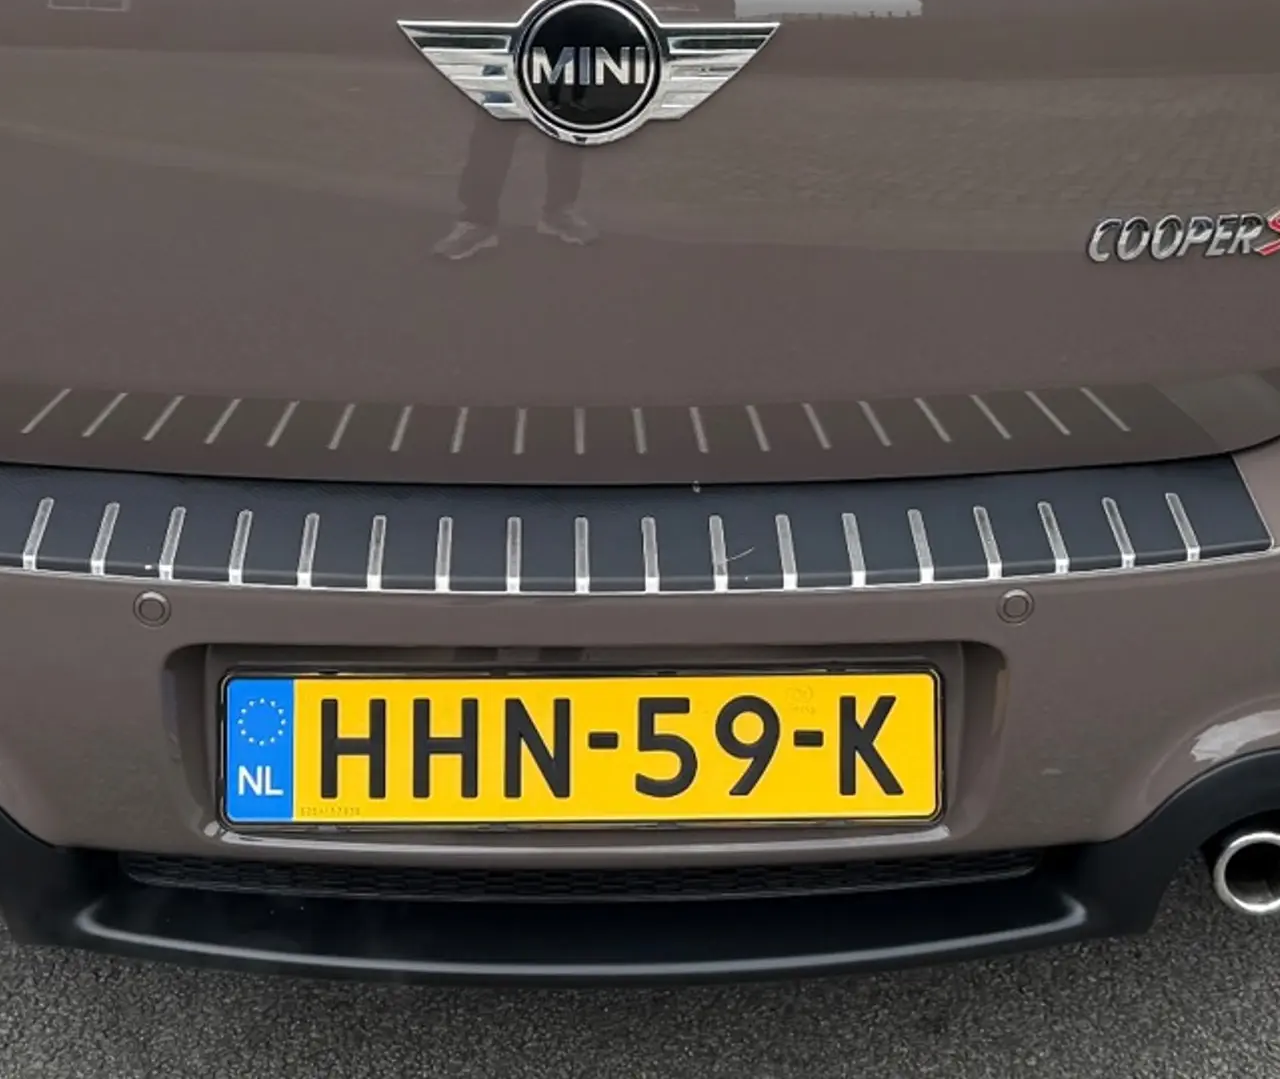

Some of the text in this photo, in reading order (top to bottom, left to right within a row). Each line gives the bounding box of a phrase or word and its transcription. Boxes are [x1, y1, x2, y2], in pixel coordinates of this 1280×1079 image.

[532, 46, 645, 86] MINI
[319, 694, 905, 799] HHN-59-K
[238, 766, 283, 797] NL
